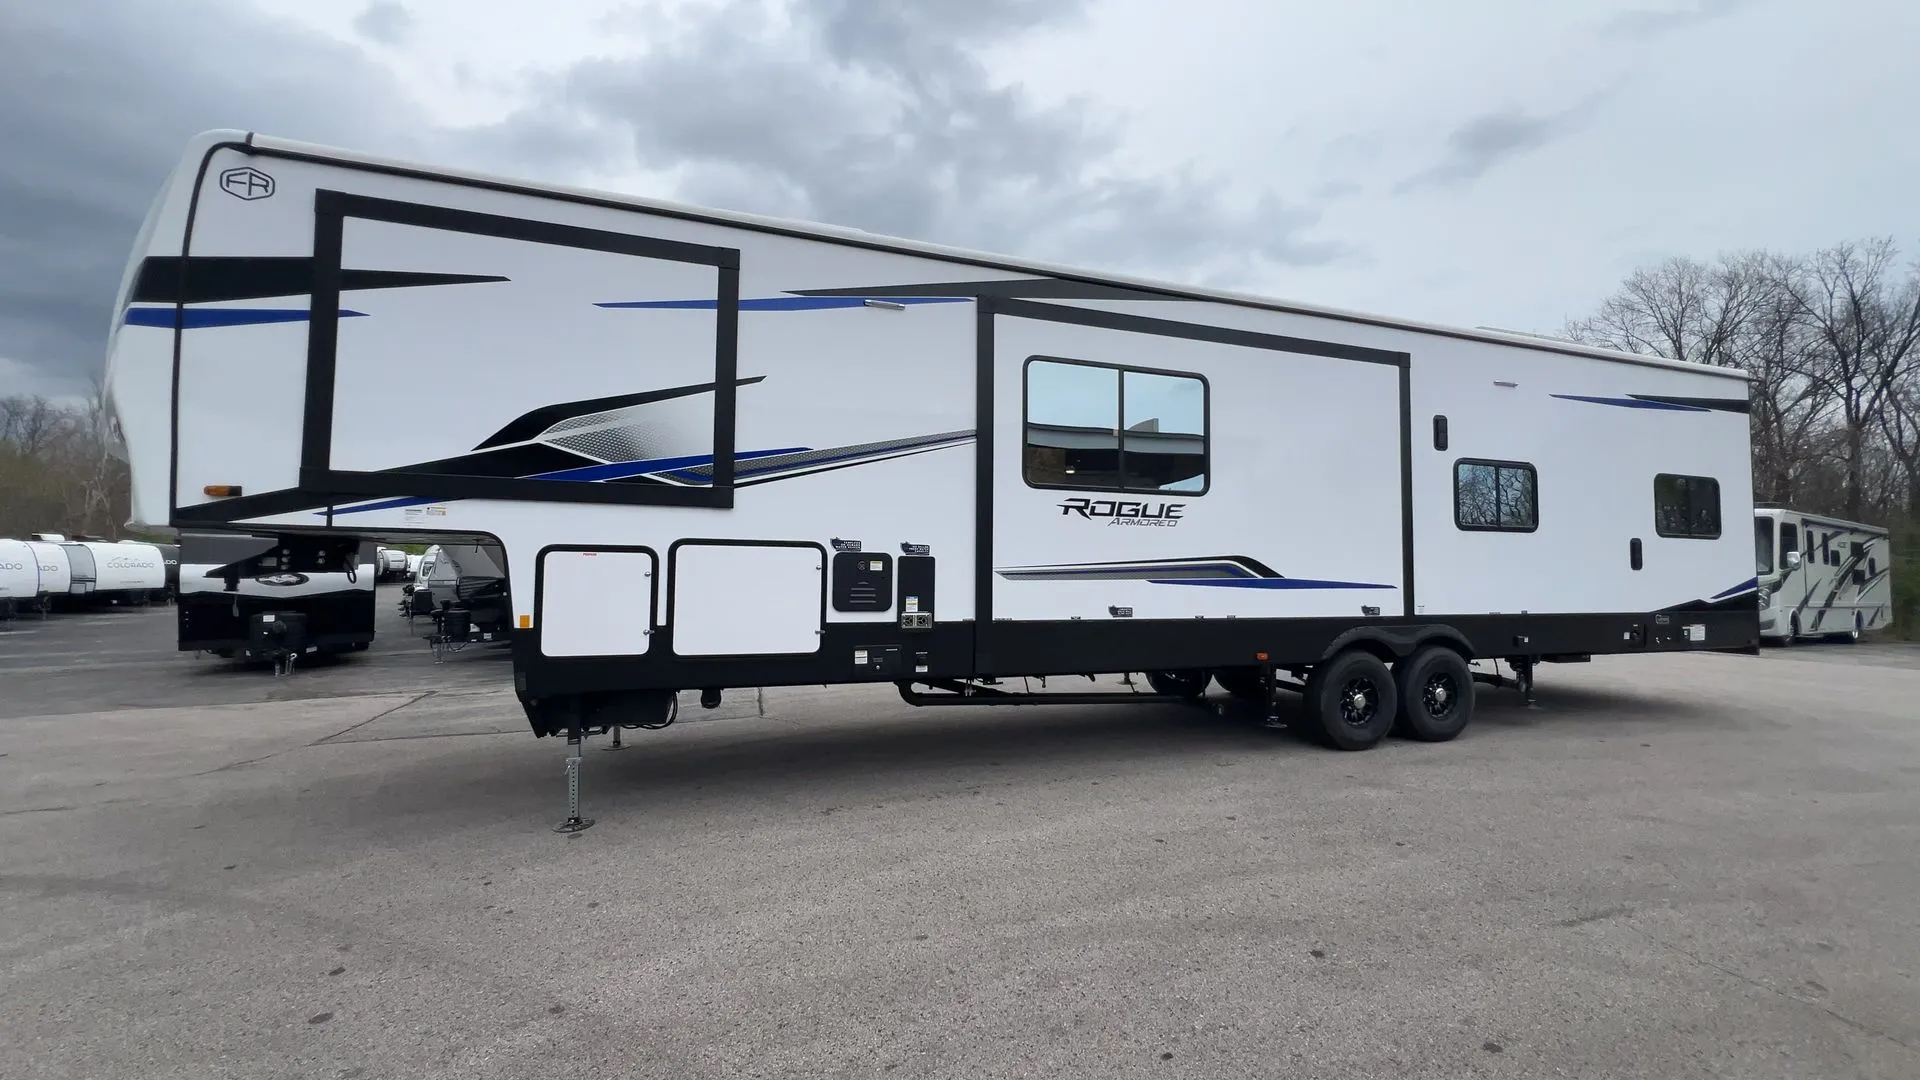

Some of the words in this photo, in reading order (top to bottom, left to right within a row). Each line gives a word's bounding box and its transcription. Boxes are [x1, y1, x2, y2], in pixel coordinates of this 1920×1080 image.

[1056, 497, 1187, 520] ROGUE
[1107, 517, 1178, 527] ARMORED
[106, 561, 155, 569] COLORADO
